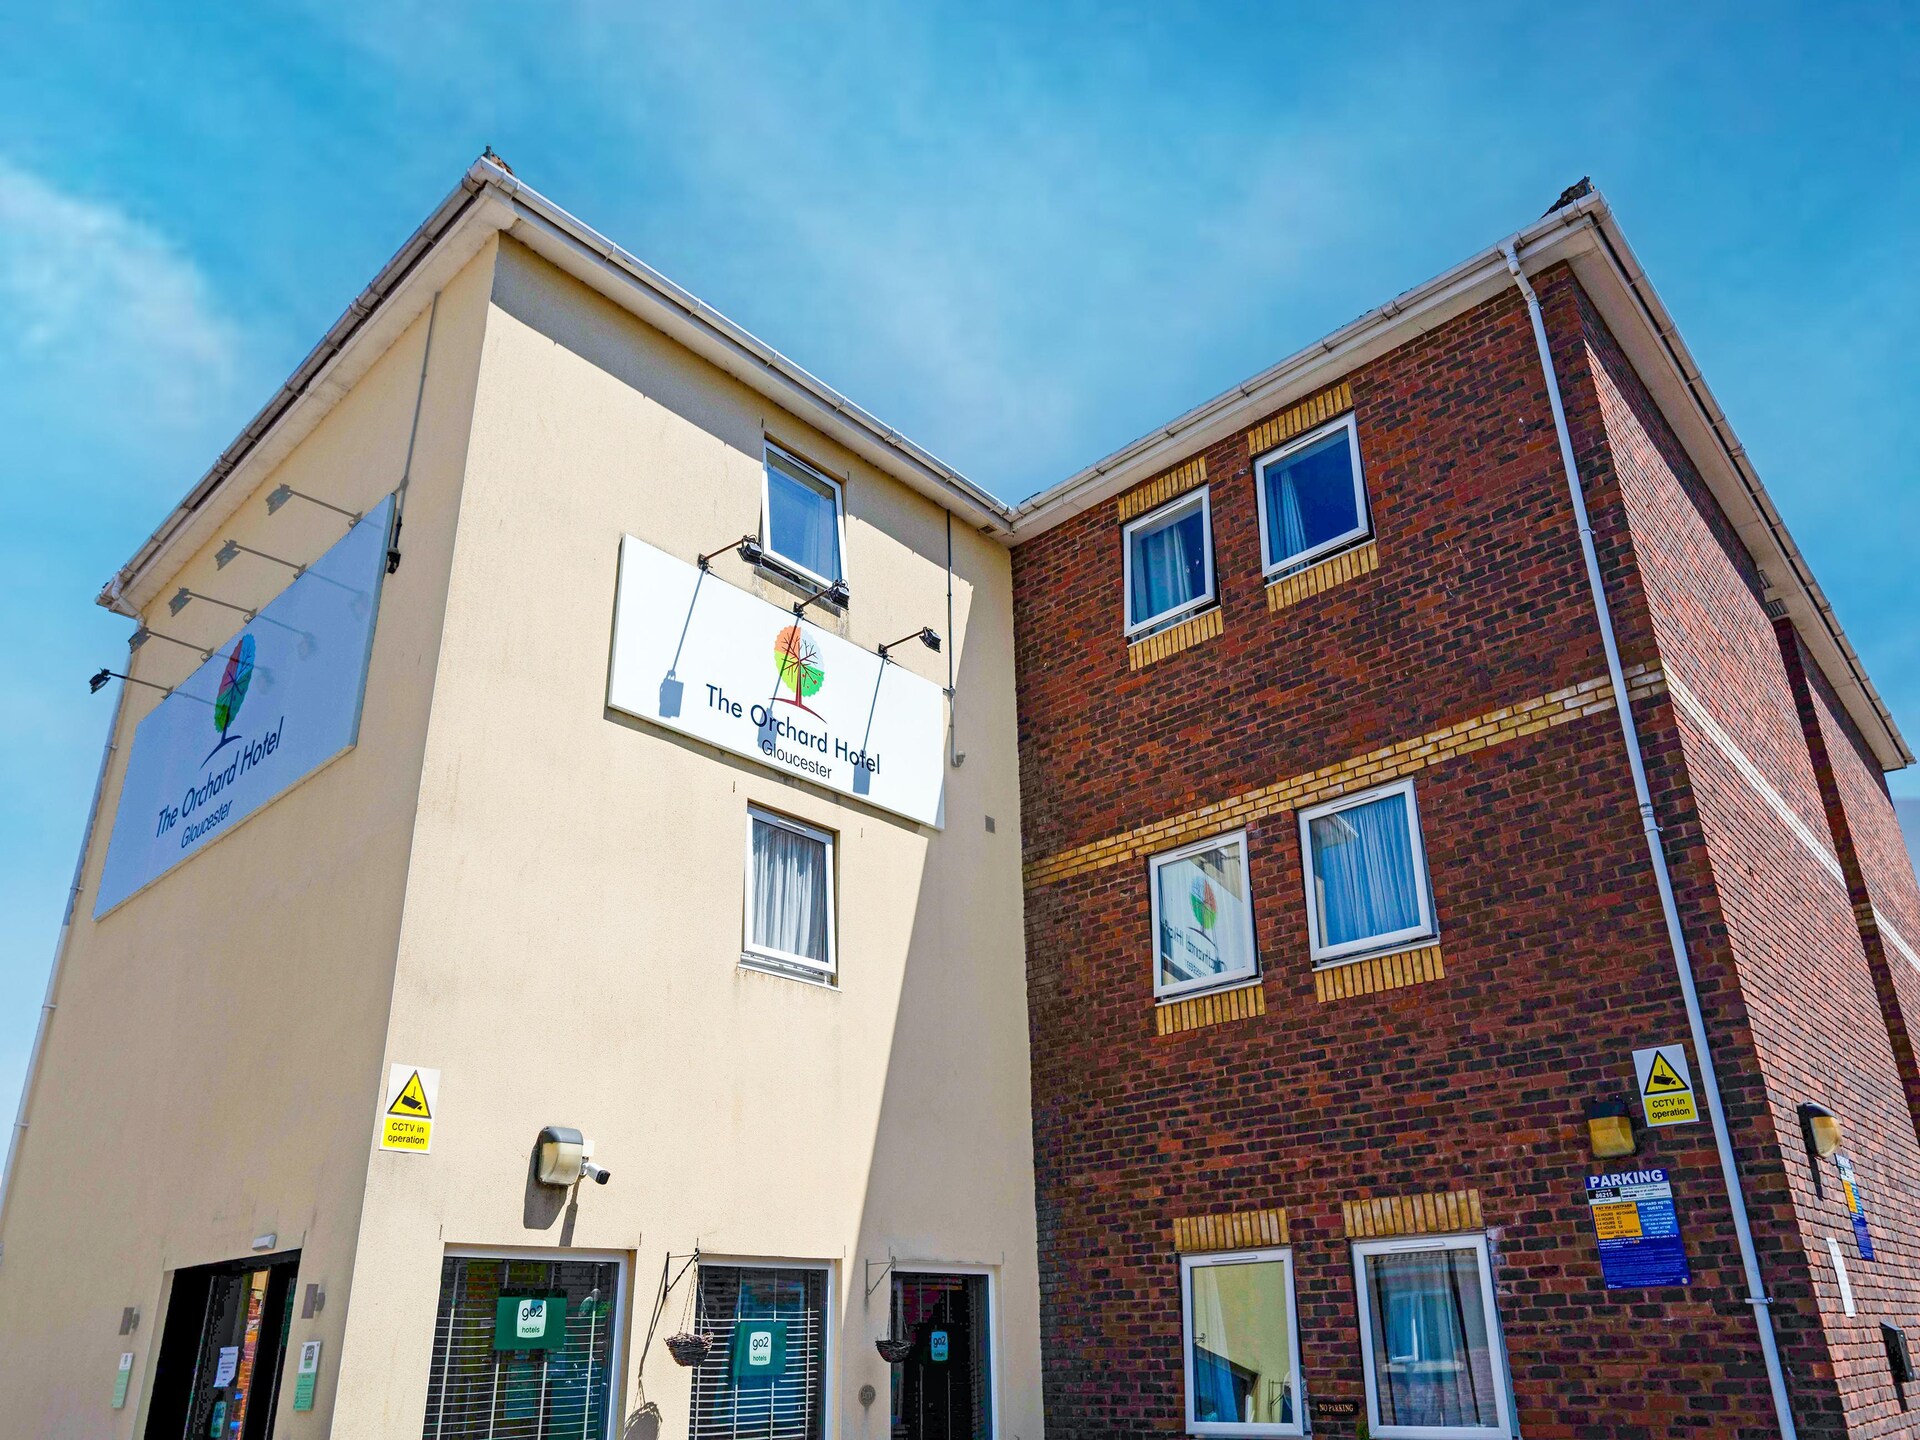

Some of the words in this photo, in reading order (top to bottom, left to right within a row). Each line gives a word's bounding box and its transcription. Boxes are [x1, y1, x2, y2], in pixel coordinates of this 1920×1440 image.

[706, 683, 743, 719] The
[750, 704, 828, 754] Orchard
[835, 738, 880, 775] Hotel
[761, 740, 833, 779] Gloucester
[156, 804, 178, 838] The
[181, 750, 240, 818] Orchard
[240, 716, 284, 775] Hotel
[181, 800, 233, 848] Gloucester
[1652, 1098, 1675, 1108] CCTV
[1652, 1108, 1690, 1119] operation
[392, 1122, 415, 1132] CCTV
[417, 1125, 424, 1133] in
[388, 1135, 425, 1144] operation
[1589, 1170, 1663, 1188] PARKING
[522, 1305, 543, 1321] go2
[753, 1336, 769, 1351] go2
[933, 1336, 947, 1348] go2
[1319, 1404, 1327, 1412] NO
[1328, 1404, 1353, 1412] PARKING
